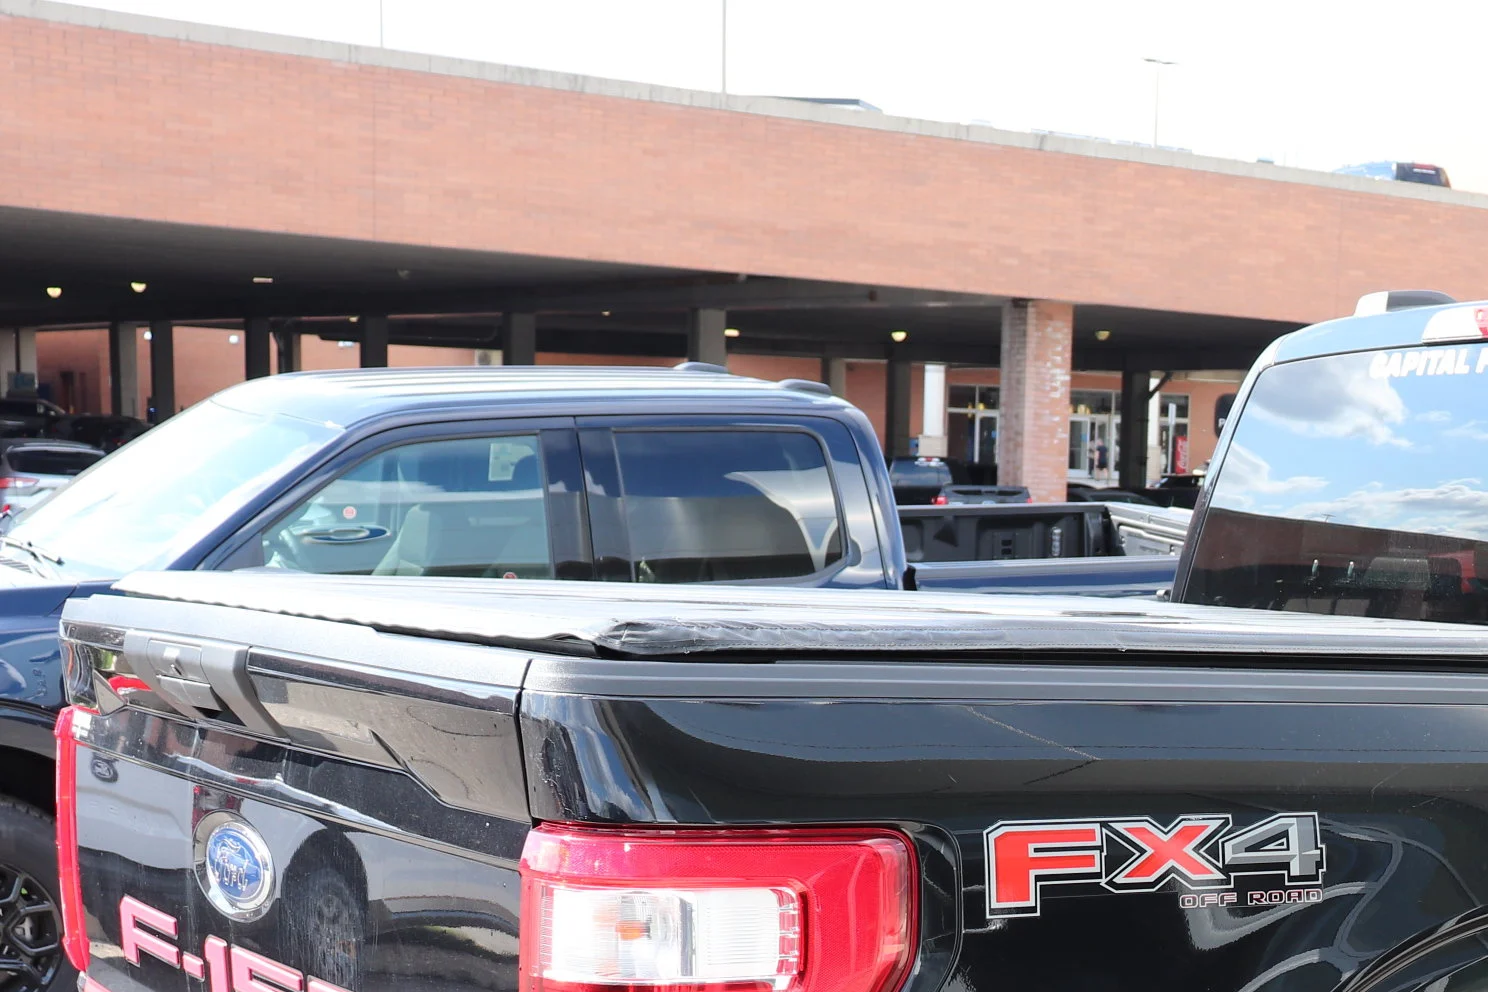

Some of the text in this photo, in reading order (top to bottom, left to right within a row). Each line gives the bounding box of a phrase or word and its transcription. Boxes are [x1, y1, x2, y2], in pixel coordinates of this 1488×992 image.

[1369, 346, 1470, 378] CAPITAL
[212, 838, 251, 892] Ford
[984, 813, 1326, 918] FX4
[1180, 888, 1323, 909] OFF ROAD
